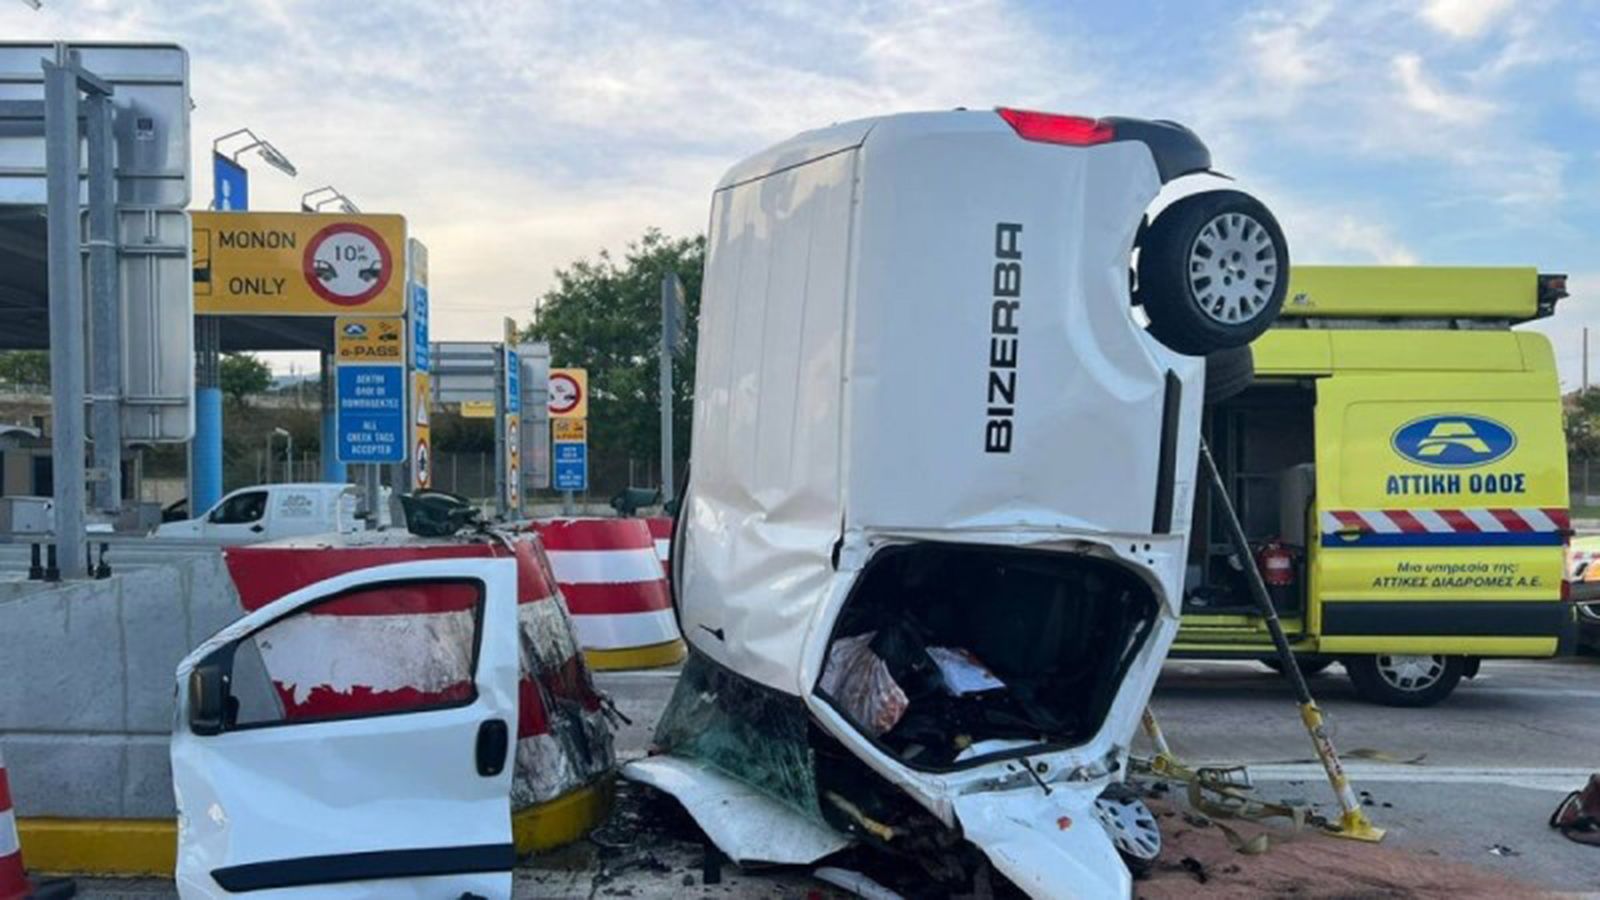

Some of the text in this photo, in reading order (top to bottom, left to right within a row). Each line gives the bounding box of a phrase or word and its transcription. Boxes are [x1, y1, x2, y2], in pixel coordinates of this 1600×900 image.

[218, 231, 296, 249] ΜΟΝΟΝ
[229, 277, 286, 294] ONLY
[984, 222, 1023, 453] BIZERBA
[341, 345, 399, 357] e-PASS
[1386, 473, 1526, 494] ΑΤΤΙΚΗ ΟΔΟΣ
[1397, 562, 1422, 573] Μια
[1372, 576, 1428, 588] ΑΤΤΙΚΕΣ
[1431, 576, 1513, 588] ΔΙΑΔΡΟΜΕΣ
